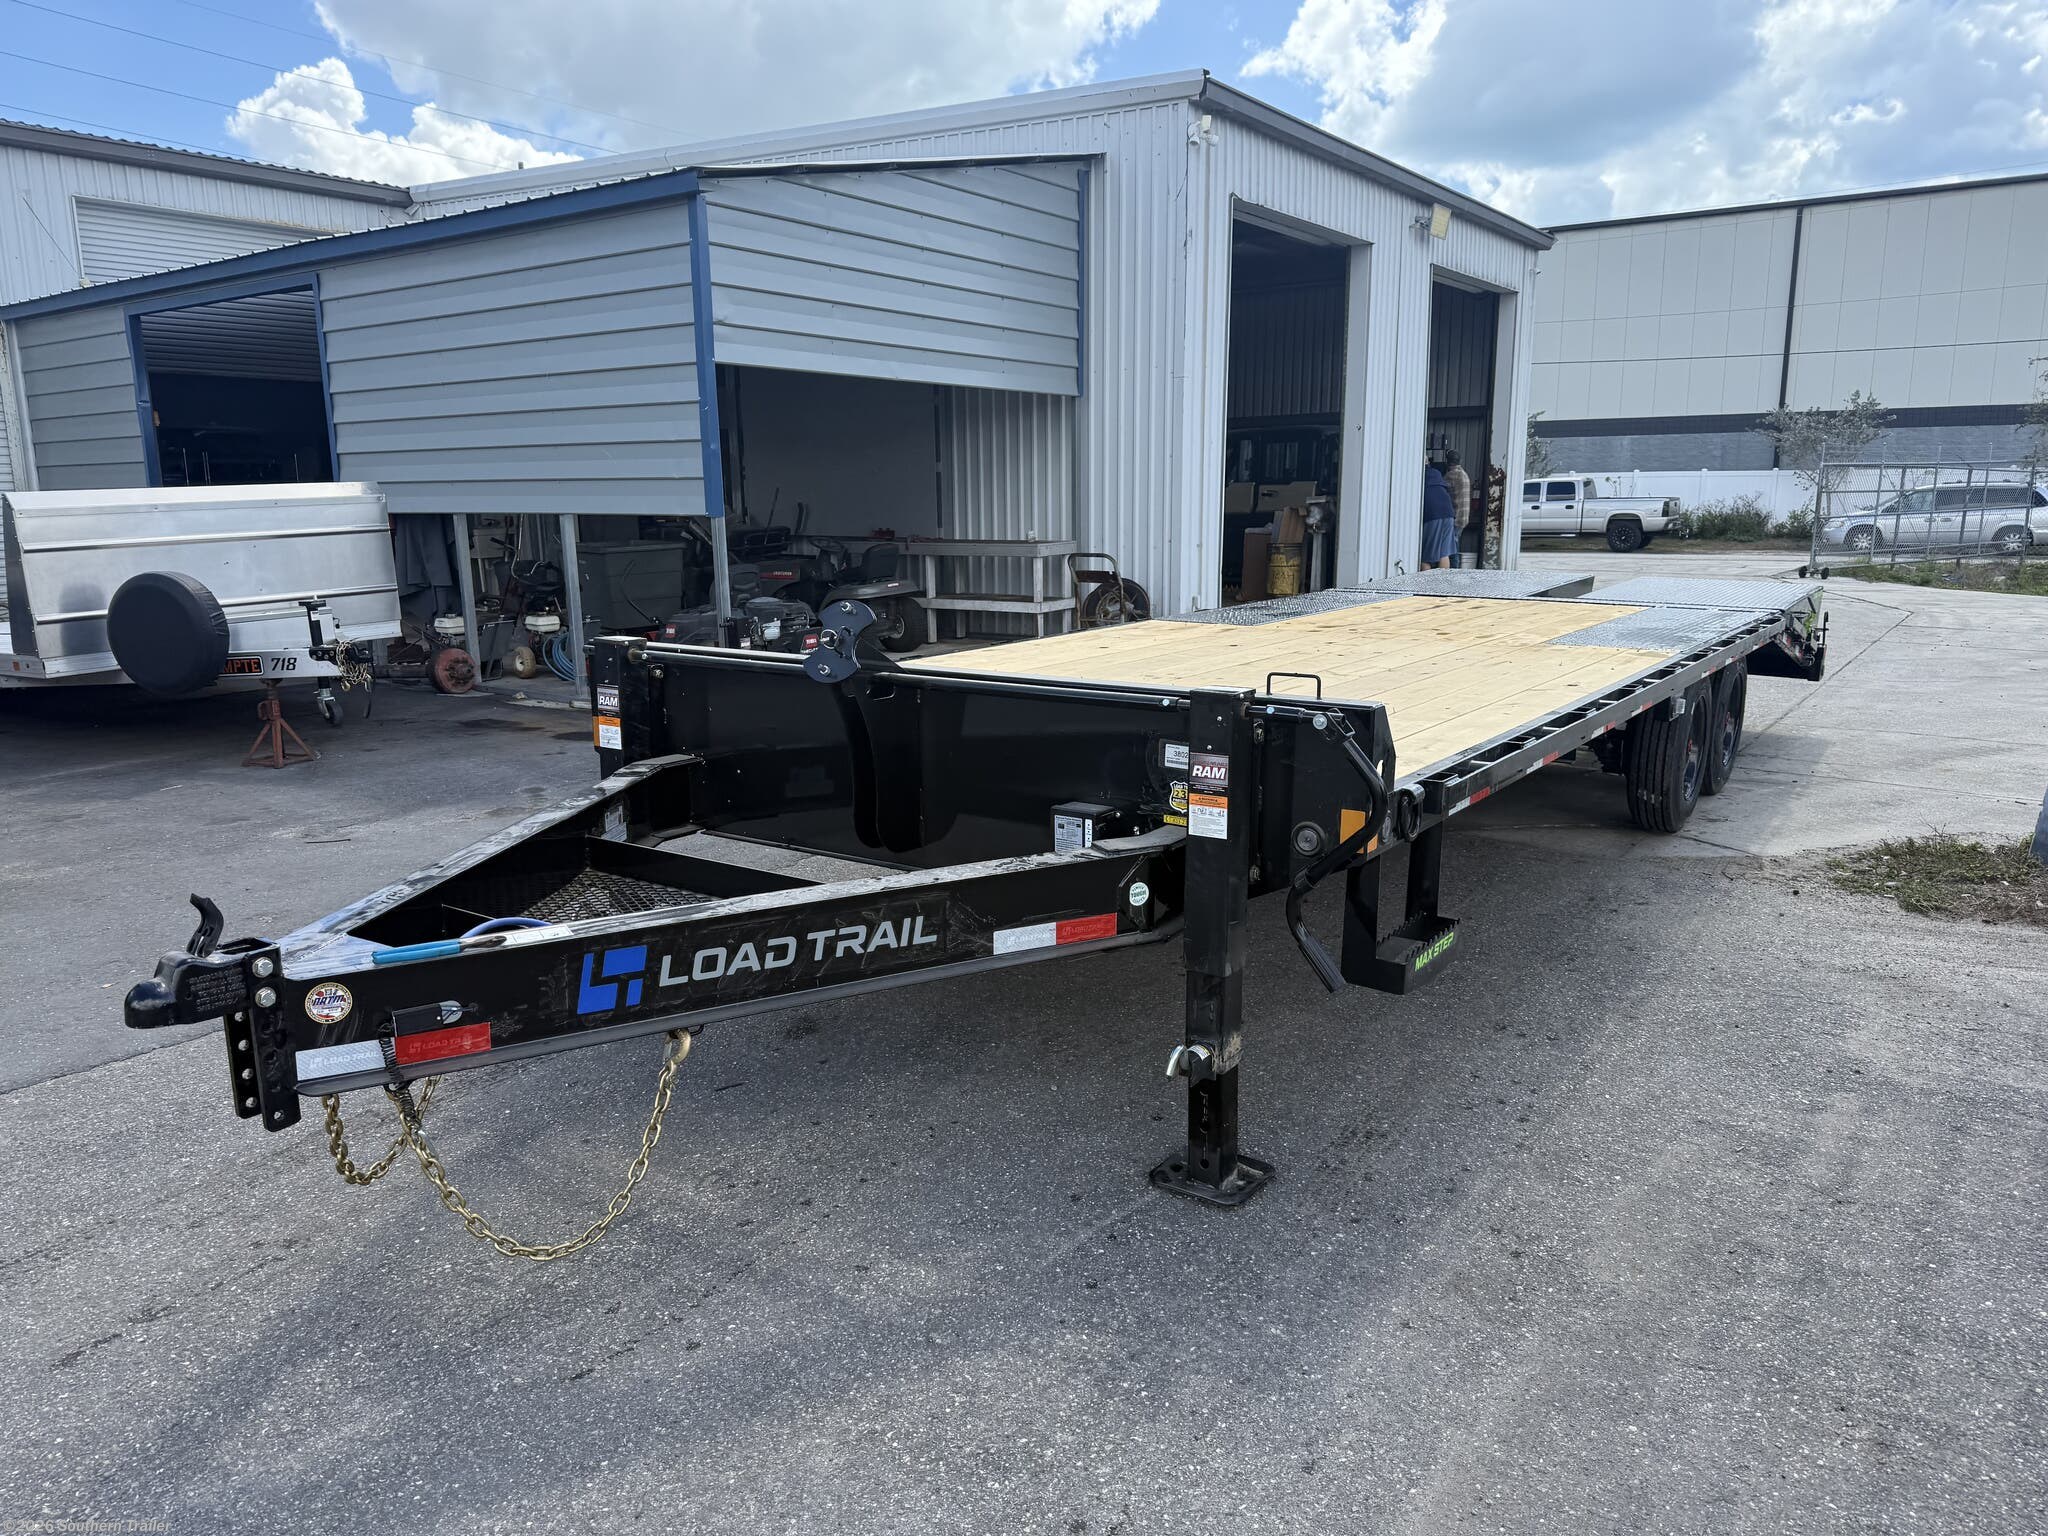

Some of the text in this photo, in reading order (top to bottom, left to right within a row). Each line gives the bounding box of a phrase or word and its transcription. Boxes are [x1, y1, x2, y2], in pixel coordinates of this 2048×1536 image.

[271, 657, 297, 671] 718
[599, 696, 618, 707] RAM
[1192, 765, 1226, 780] RAM
[659, 936, 797, 987] LOAD
[807, 916, 938, 961] TRAIL
